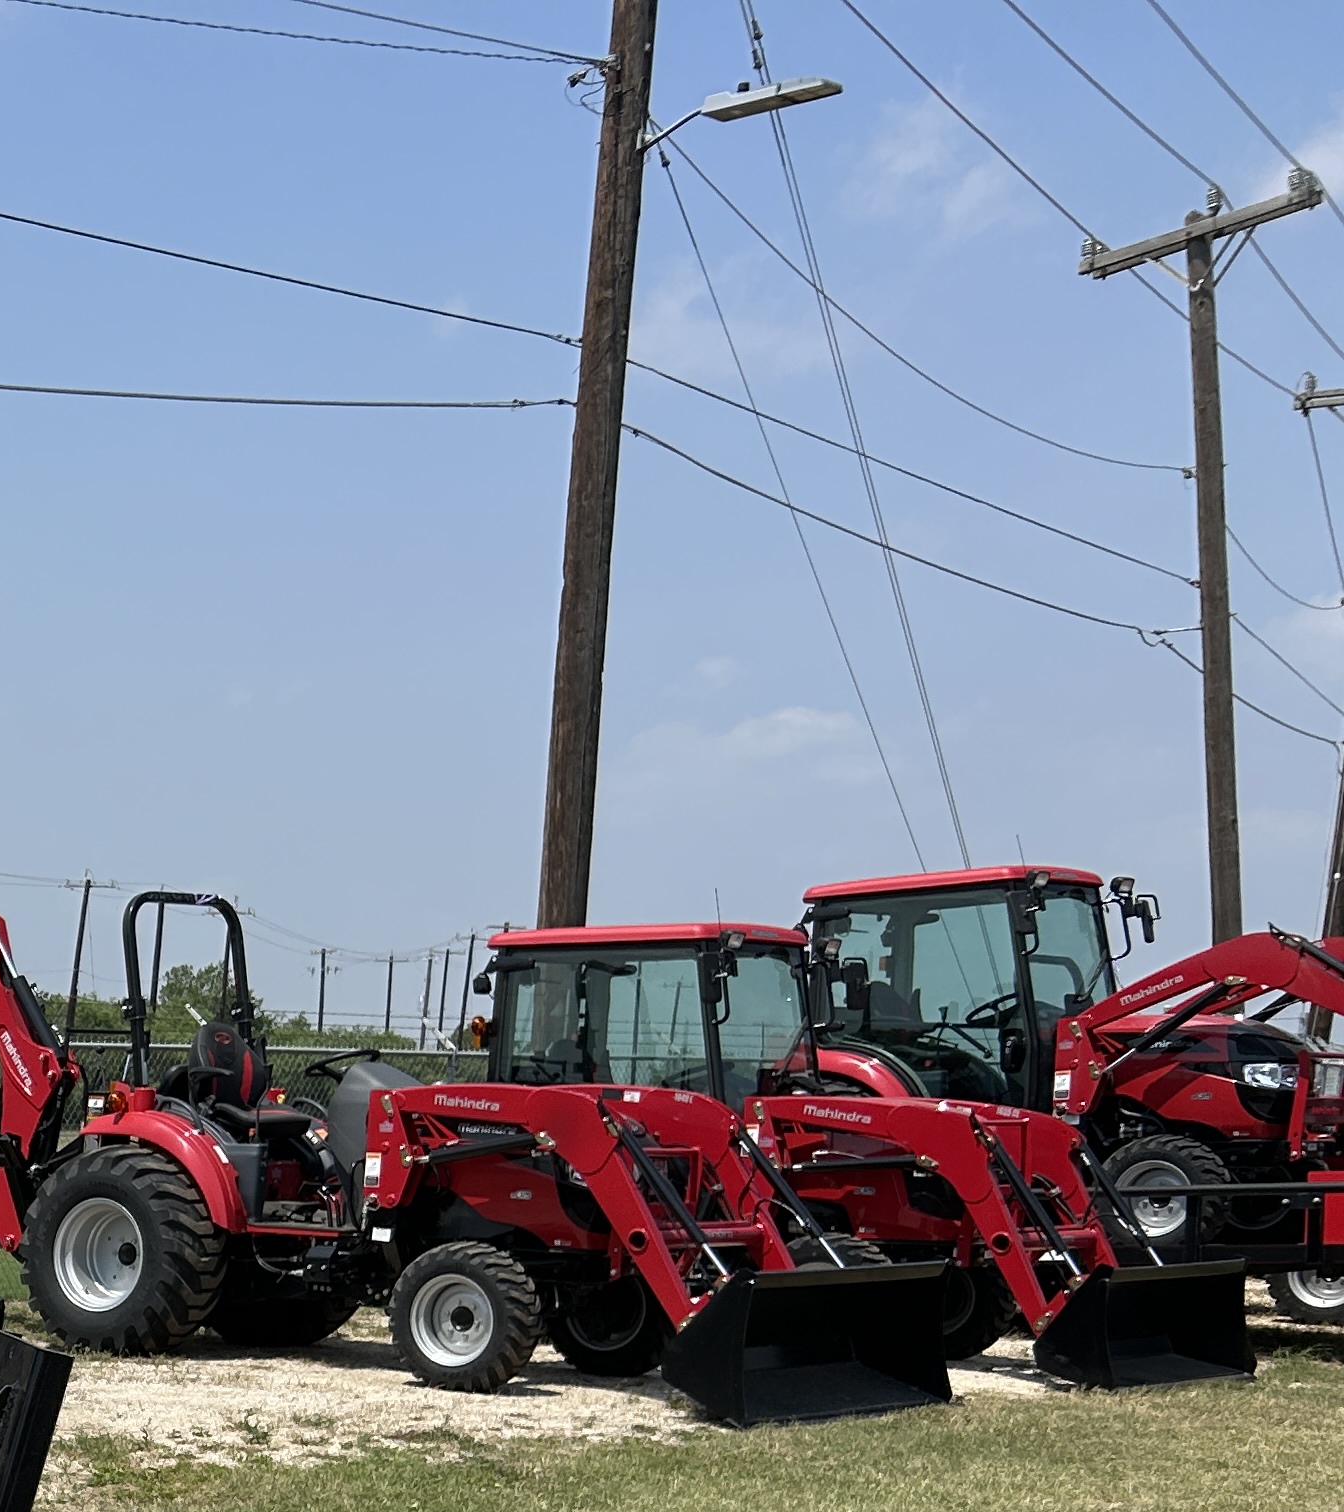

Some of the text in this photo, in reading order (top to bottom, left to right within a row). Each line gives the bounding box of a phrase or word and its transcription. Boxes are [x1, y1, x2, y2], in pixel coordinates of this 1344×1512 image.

[1120, 974, 1184, 1006] Mahindra
[0, 1030, 34, 1089] Mahindra
[434, 1093, 501, 1112] Mahindra
[803, 1103, 872, 1125] Mahindra
